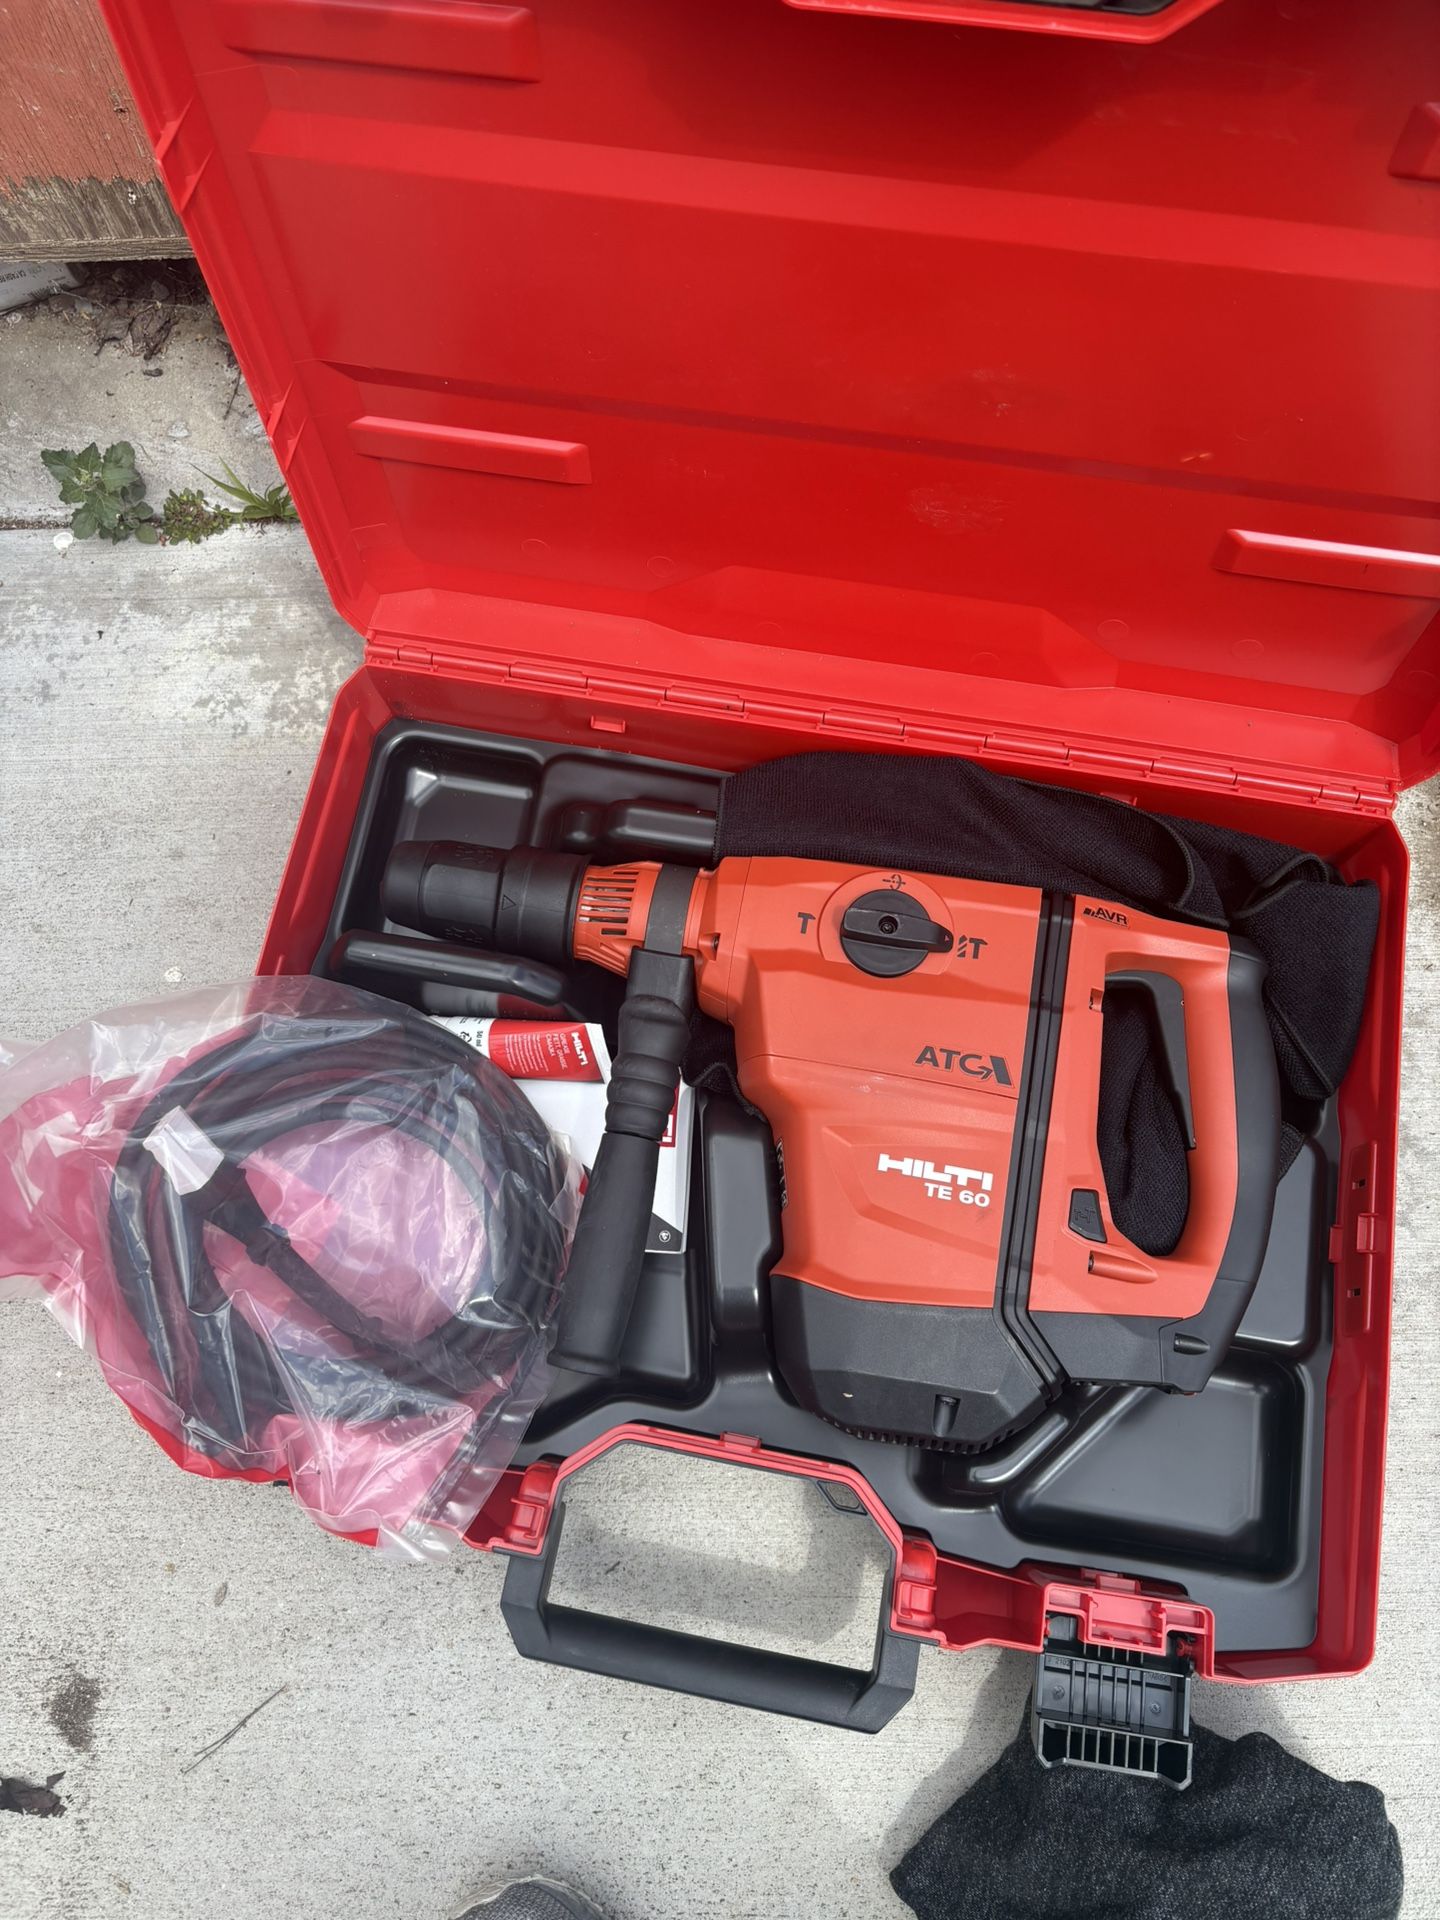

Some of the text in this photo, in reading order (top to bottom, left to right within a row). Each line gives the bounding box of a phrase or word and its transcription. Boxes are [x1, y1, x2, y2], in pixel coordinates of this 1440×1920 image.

[1096, 907, 1128, 925] AVR
[559, 1032, 571, 1054] GREASE
[571, 1031, 588, 1066] HILTI
[878, 1153, 993, 1191] HILTI
[924, 1182, 990, 1208] TE 60
